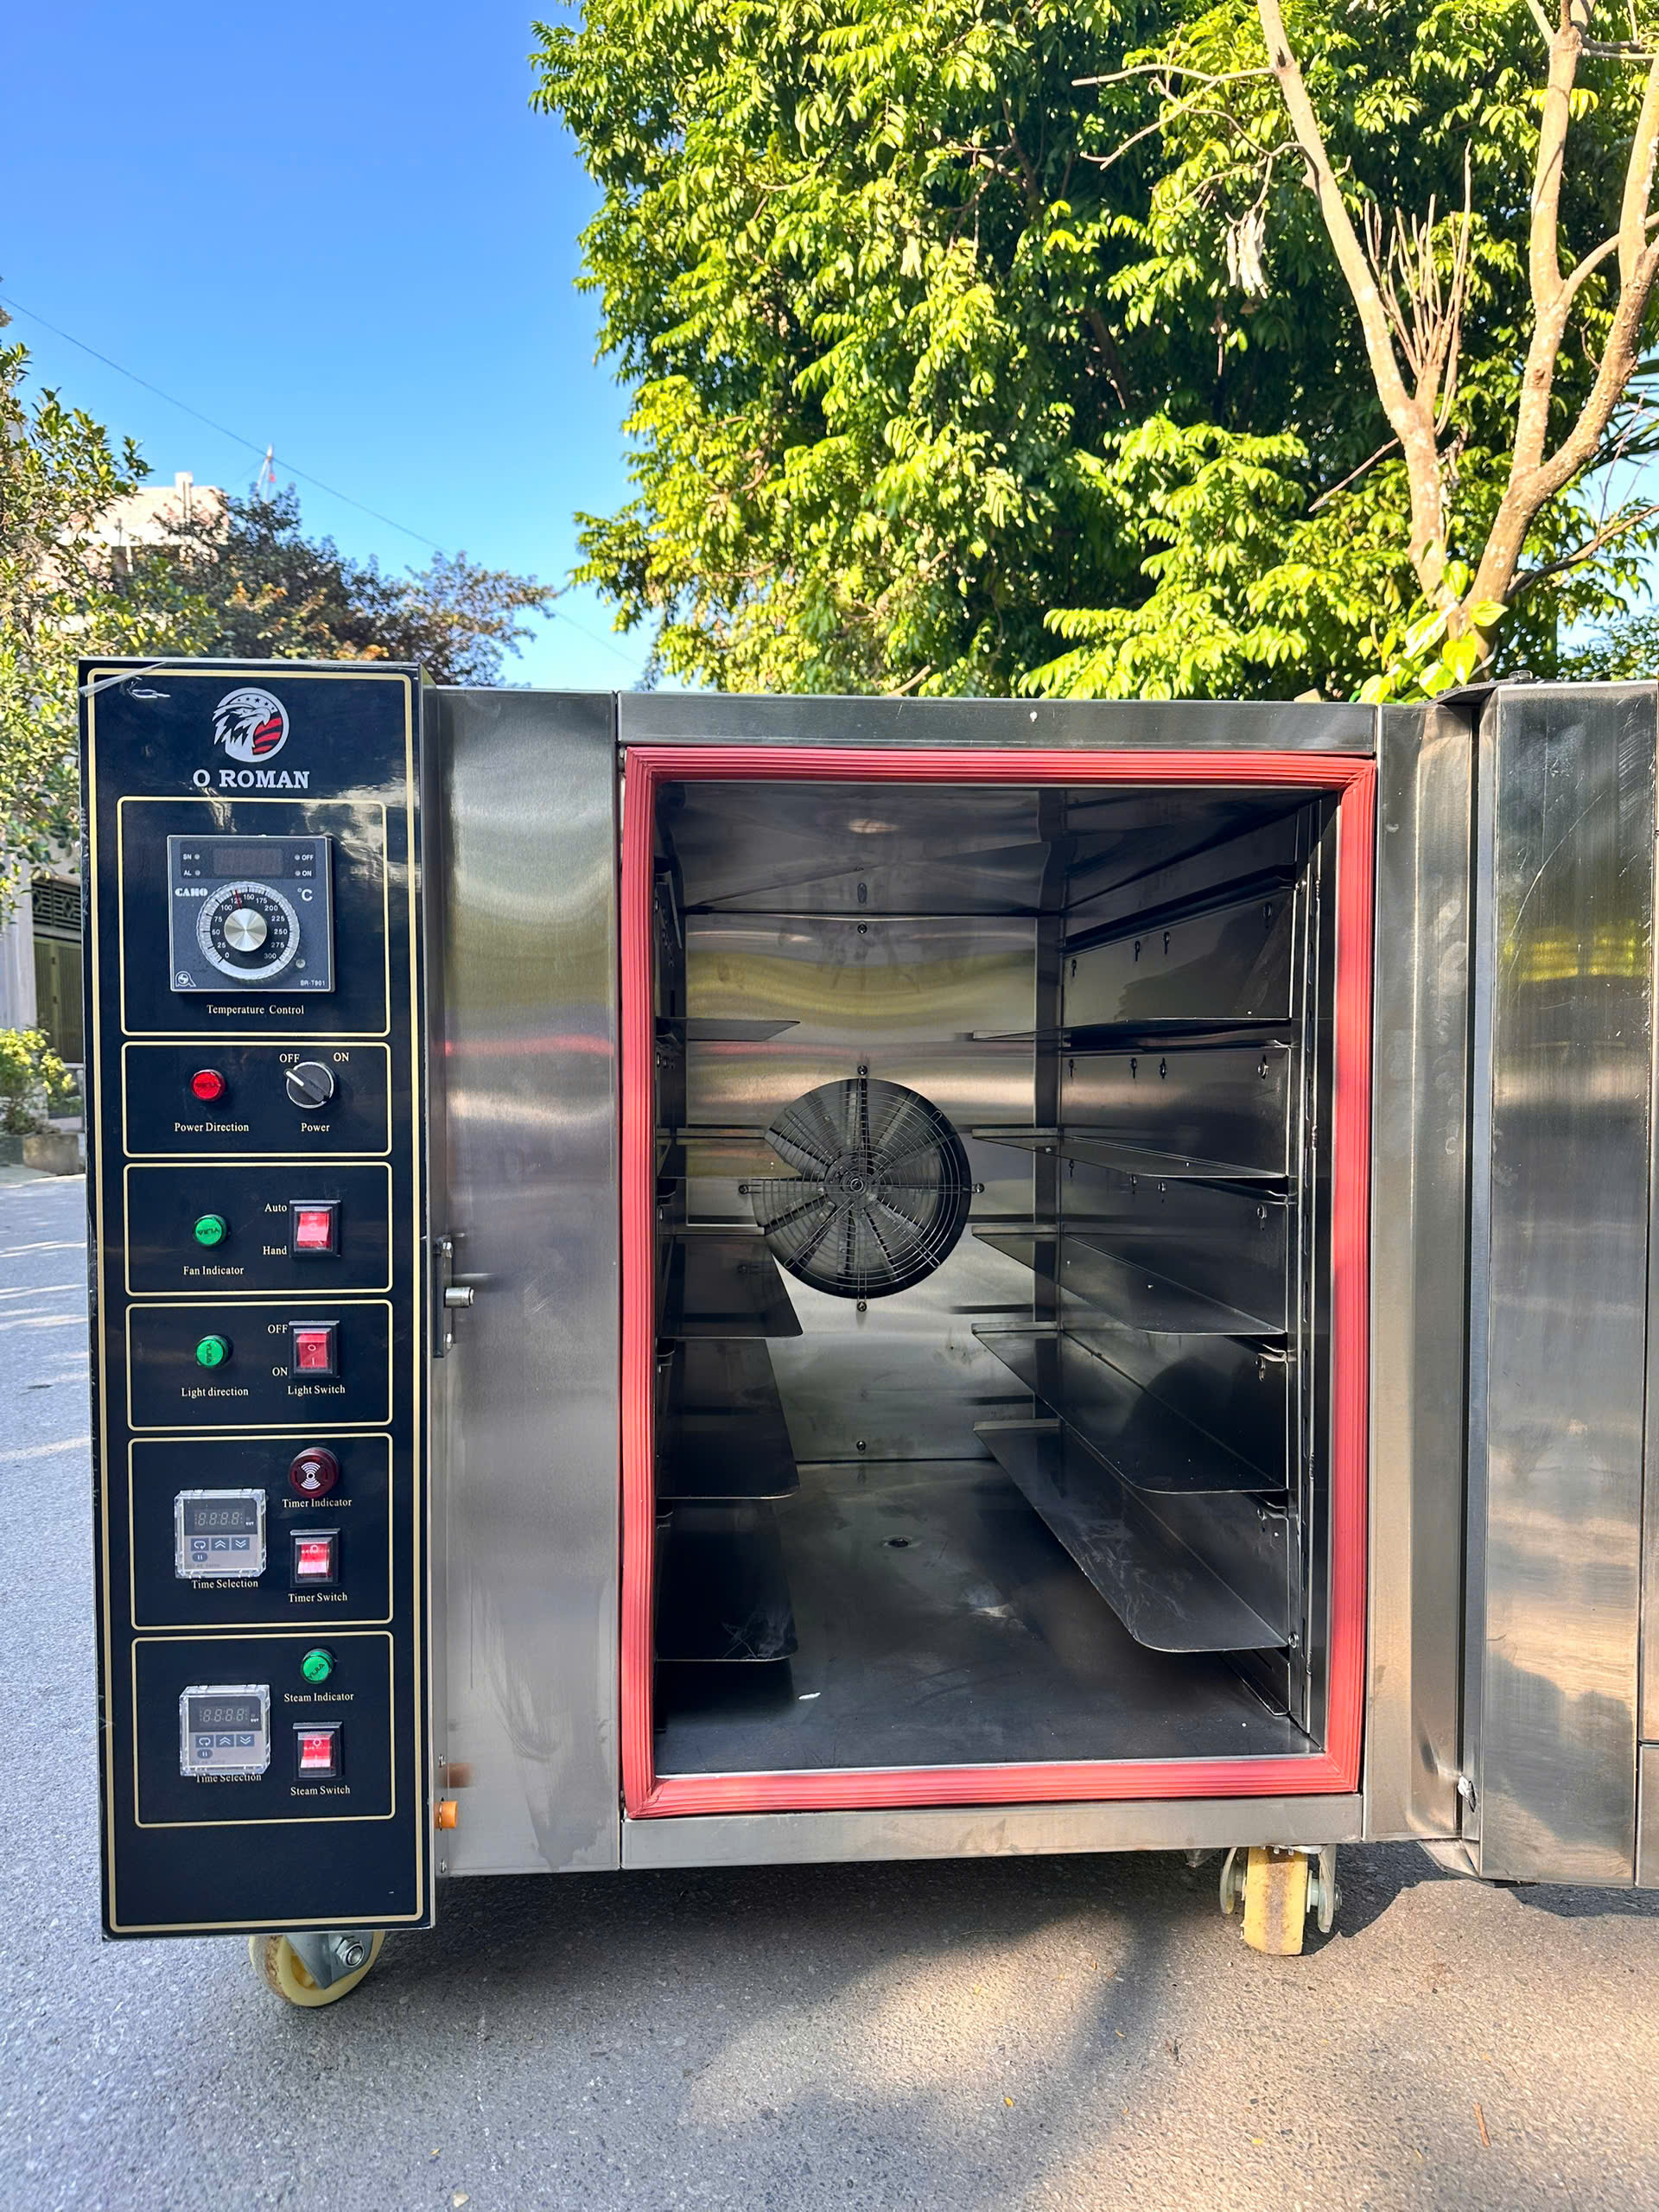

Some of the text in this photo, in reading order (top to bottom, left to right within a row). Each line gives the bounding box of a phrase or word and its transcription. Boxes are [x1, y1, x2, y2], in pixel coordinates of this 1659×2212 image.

[193, 769, 310, 789] O ROMAN
[207, 1004, 304, 1015] Temperature Control
[279, 1053, 301, 1064] OFF
[334, 1052, 350, 1063] ON
[175, 1122, 250, 1133] Power Direction
[301, 1122, 330, 1133] Power
[264, 1203, 288, 1213] Auto
[263, 1246, 288, 1256] Hand
[183, 1266, 244, 1276] Fan Indicator
[267, 1325, 289, 1334] OFF
[271, 1367, 289, 1376] ON
[181, 1386, 249, 1399] Light direction
[288, 1384, 346, 1397] Light Switch
[283, 1497, 353, 1508] Timer Indicator
[191, 1578, 259, 1589] Time Selection
[288, 1592, 348, 1603] Timer Switch
[283, 1691, 355, 1703] Steam Indicator
[197, 1773, 263, 1783] Time Selection
[290, 1784, 351, 1796] Steam Switch
